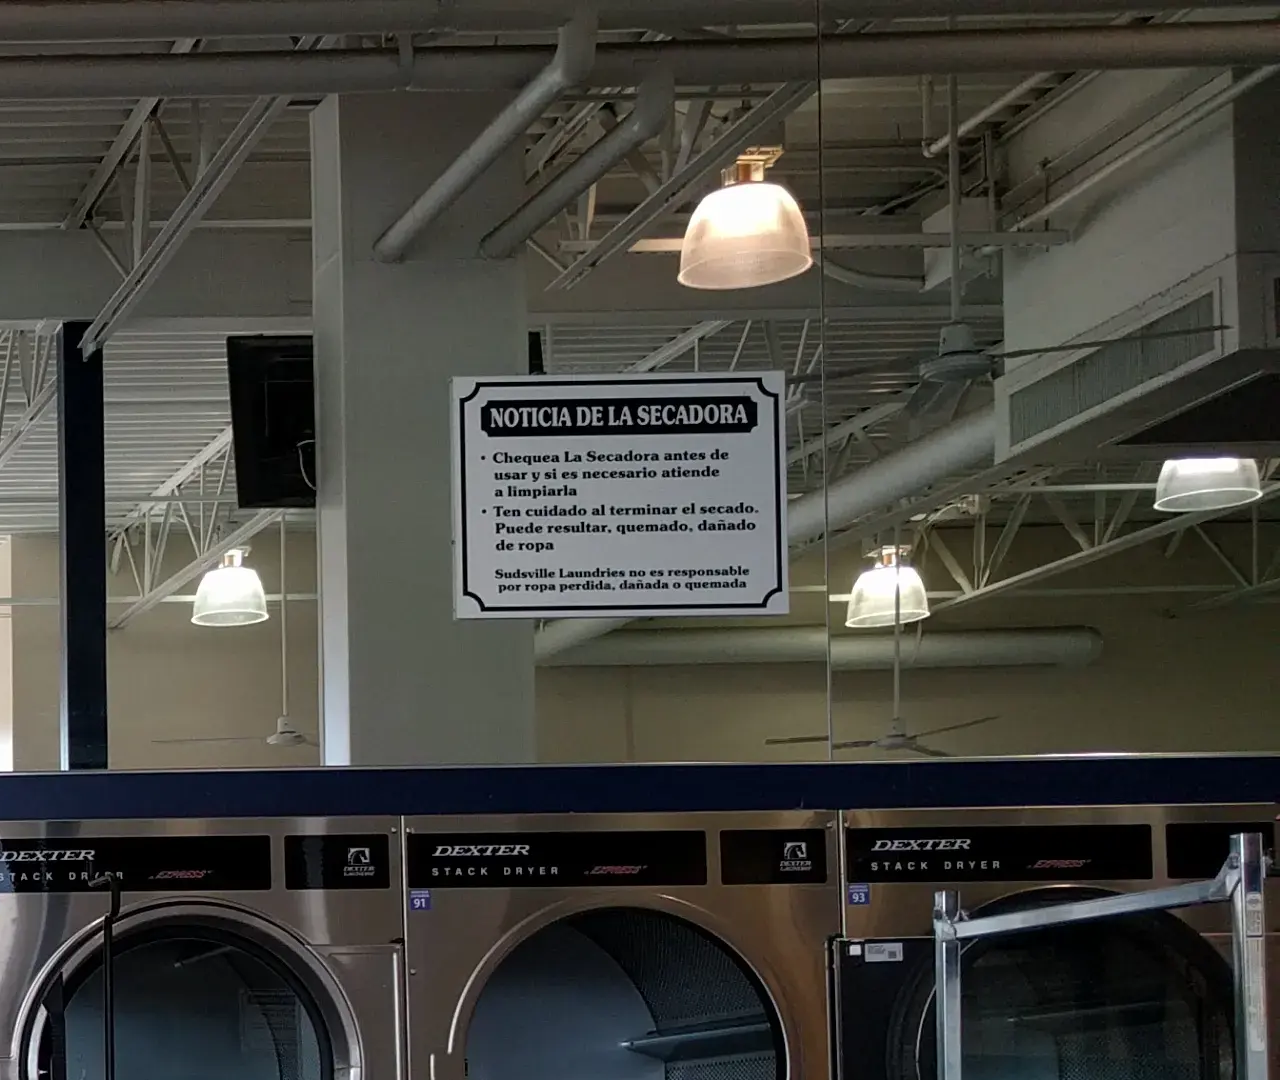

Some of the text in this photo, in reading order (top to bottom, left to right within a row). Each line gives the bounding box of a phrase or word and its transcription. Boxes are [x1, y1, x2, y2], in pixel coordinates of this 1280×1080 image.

[491, 404, 748, 428] NOTICIA DE LA SECADORA
[493, 449, 729, 466] Chequea La Secadora antes de
[495, 466, 720, 483] usar y si es necesario atiende
[494, 485, 577, 499] a limpiarla
[494, 503, 759, 517] Ten cuidado al terminar el secado.
[496, 519, 757, 535] Puede resultar, quemado, dañado
[496, 540, 554, 553] de ropa
[495, 569, 556, 579] Sudsville
[560, 568, 625, 578] Laundries
[629, 570, 646, 578] no
[668, 566, 750, 579] responsable
[499, 585, 522, 594] por
[525, 584, 556, 593] ropa
[560, 580, 616, 593] perdida,
[620, 580, 669, 590] dañada
[685, 579, 747, 591] quemada
[431, 844, 531, 857] DEXTER
[871, 838, 972, 851] DEXTER
[431, 865, 560, 877] STACK DRYER
[871, 860, 1001, 871] STACK DRYER
[414, 898, 426, 907] 91
[852, 893, 865, 902] 93
